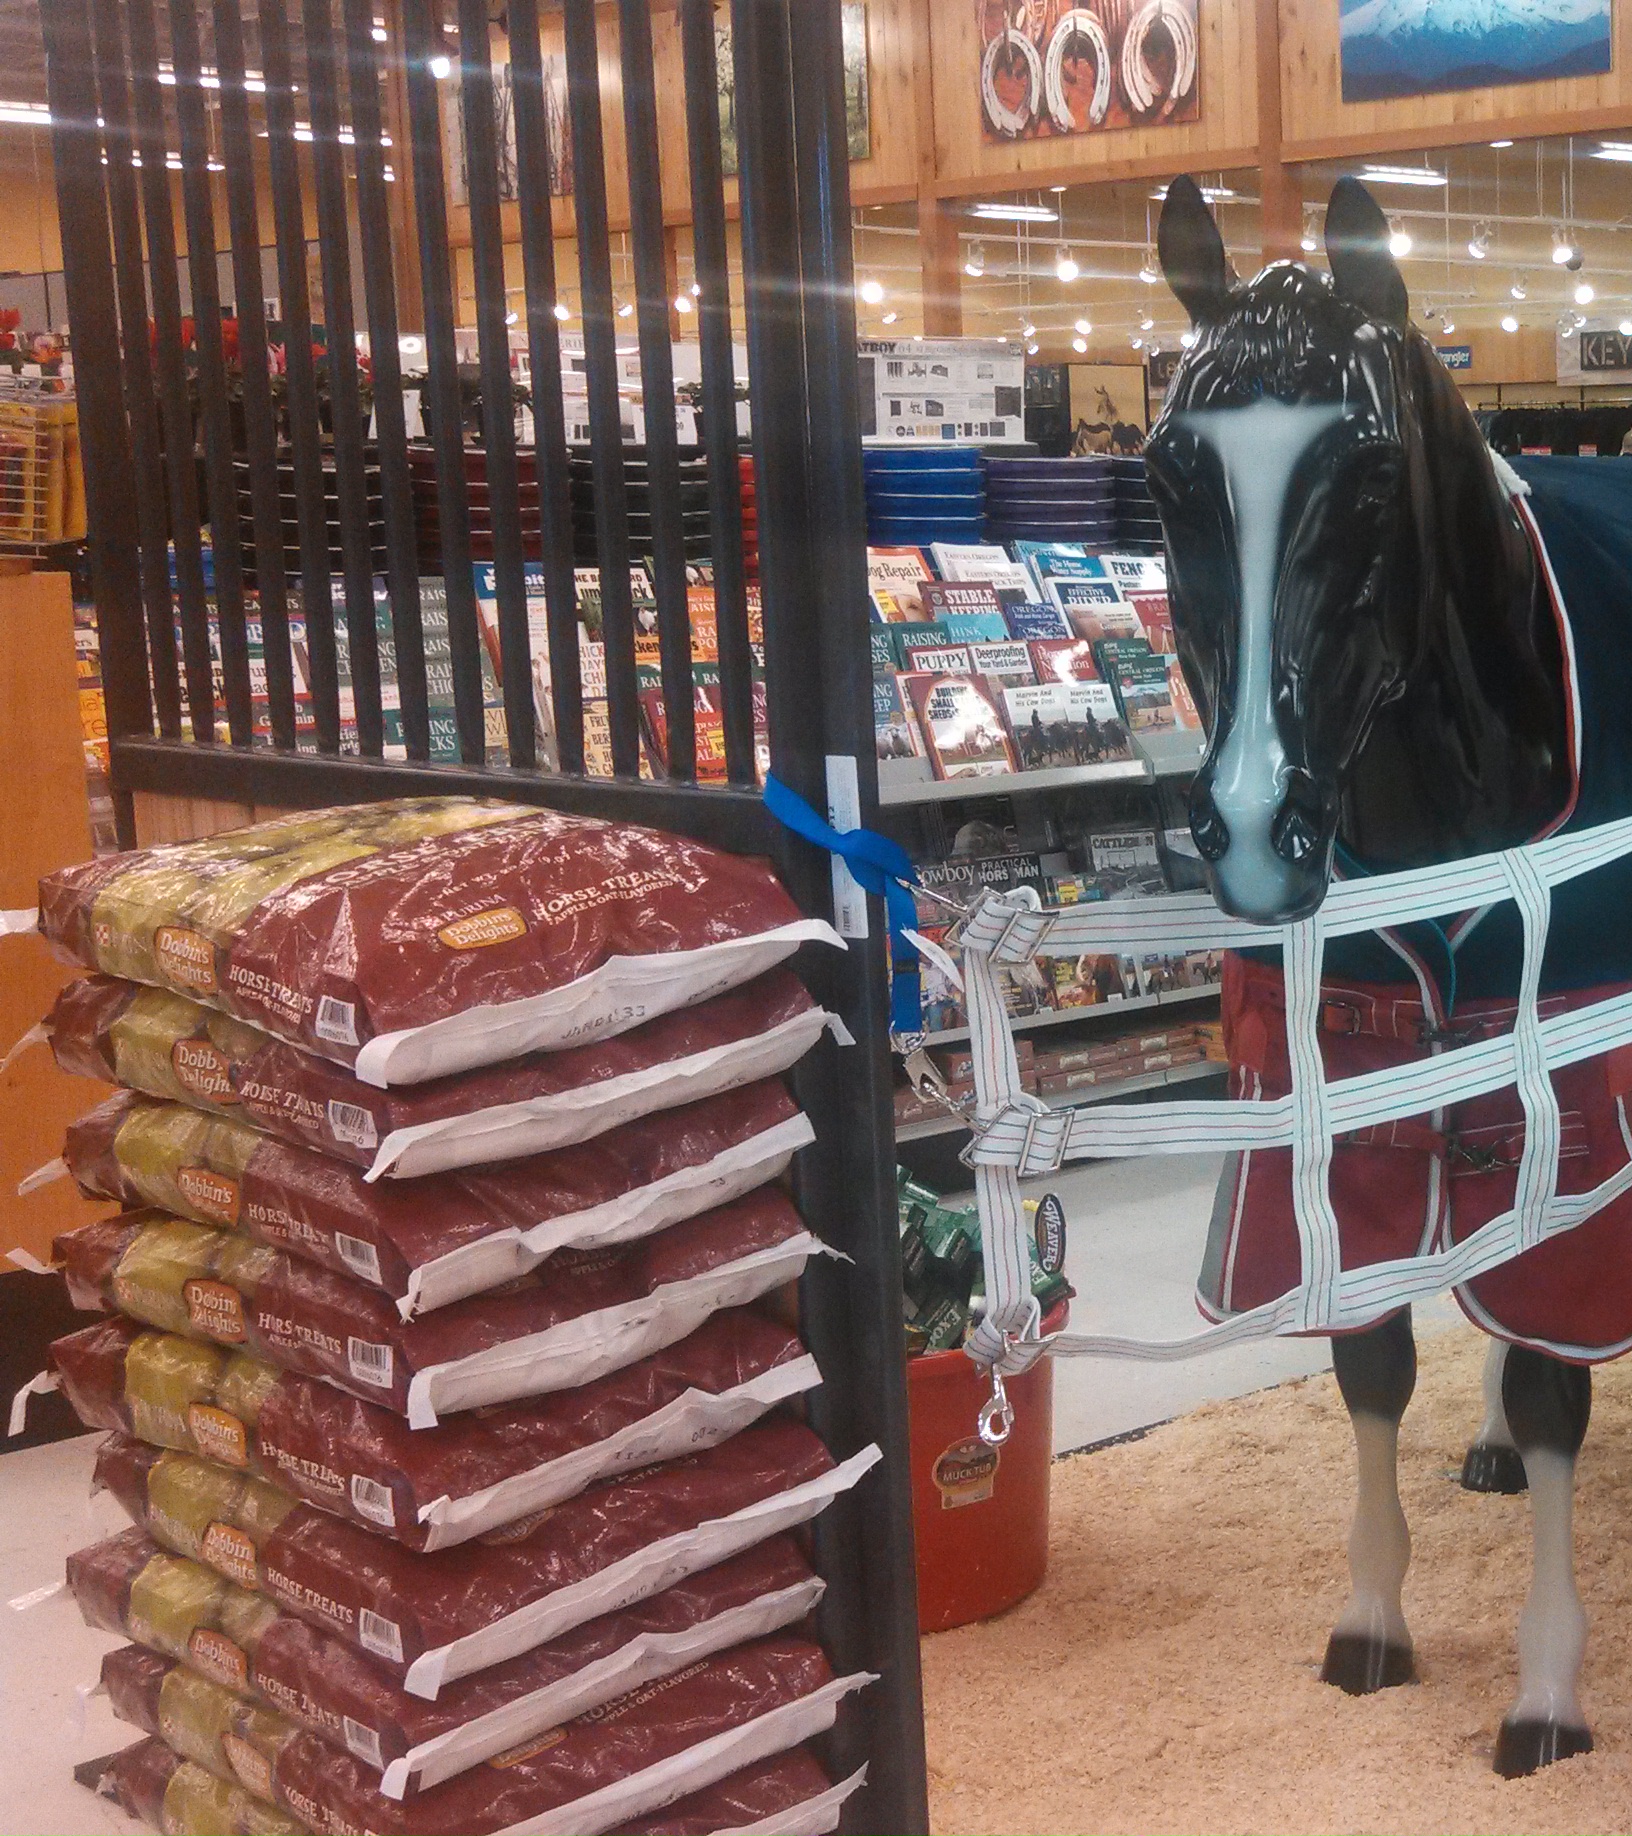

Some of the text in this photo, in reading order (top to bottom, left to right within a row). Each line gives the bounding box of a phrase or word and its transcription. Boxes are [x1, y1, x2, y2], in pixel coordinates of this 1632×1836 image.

[885, 561, 922, 581] Repair
[944, 588, 997, 604] STABLE
[902, 632, 948, 647] RAISING
[914, 652, 967, 671] PUPPY
[975, 645, 1026, 661] Deerproofing
[1039, 689, 1053, 698] And
[1091, 688, 1104, 697] And
[981, 857, 1032, 871] PRACTICAL
[920, 862, 975, 886] owboy
[977, 866, 1040, 884] HORSMAN
[533, 885, 601, 921] HORSE
[456, 922, 519, 945] Delights
[1042, 1199, 1063, 1273] WEAVER
[942, 1467, 973, 1482] MUCK
[266, 1565, 355, 1625] HORSE TREATS
